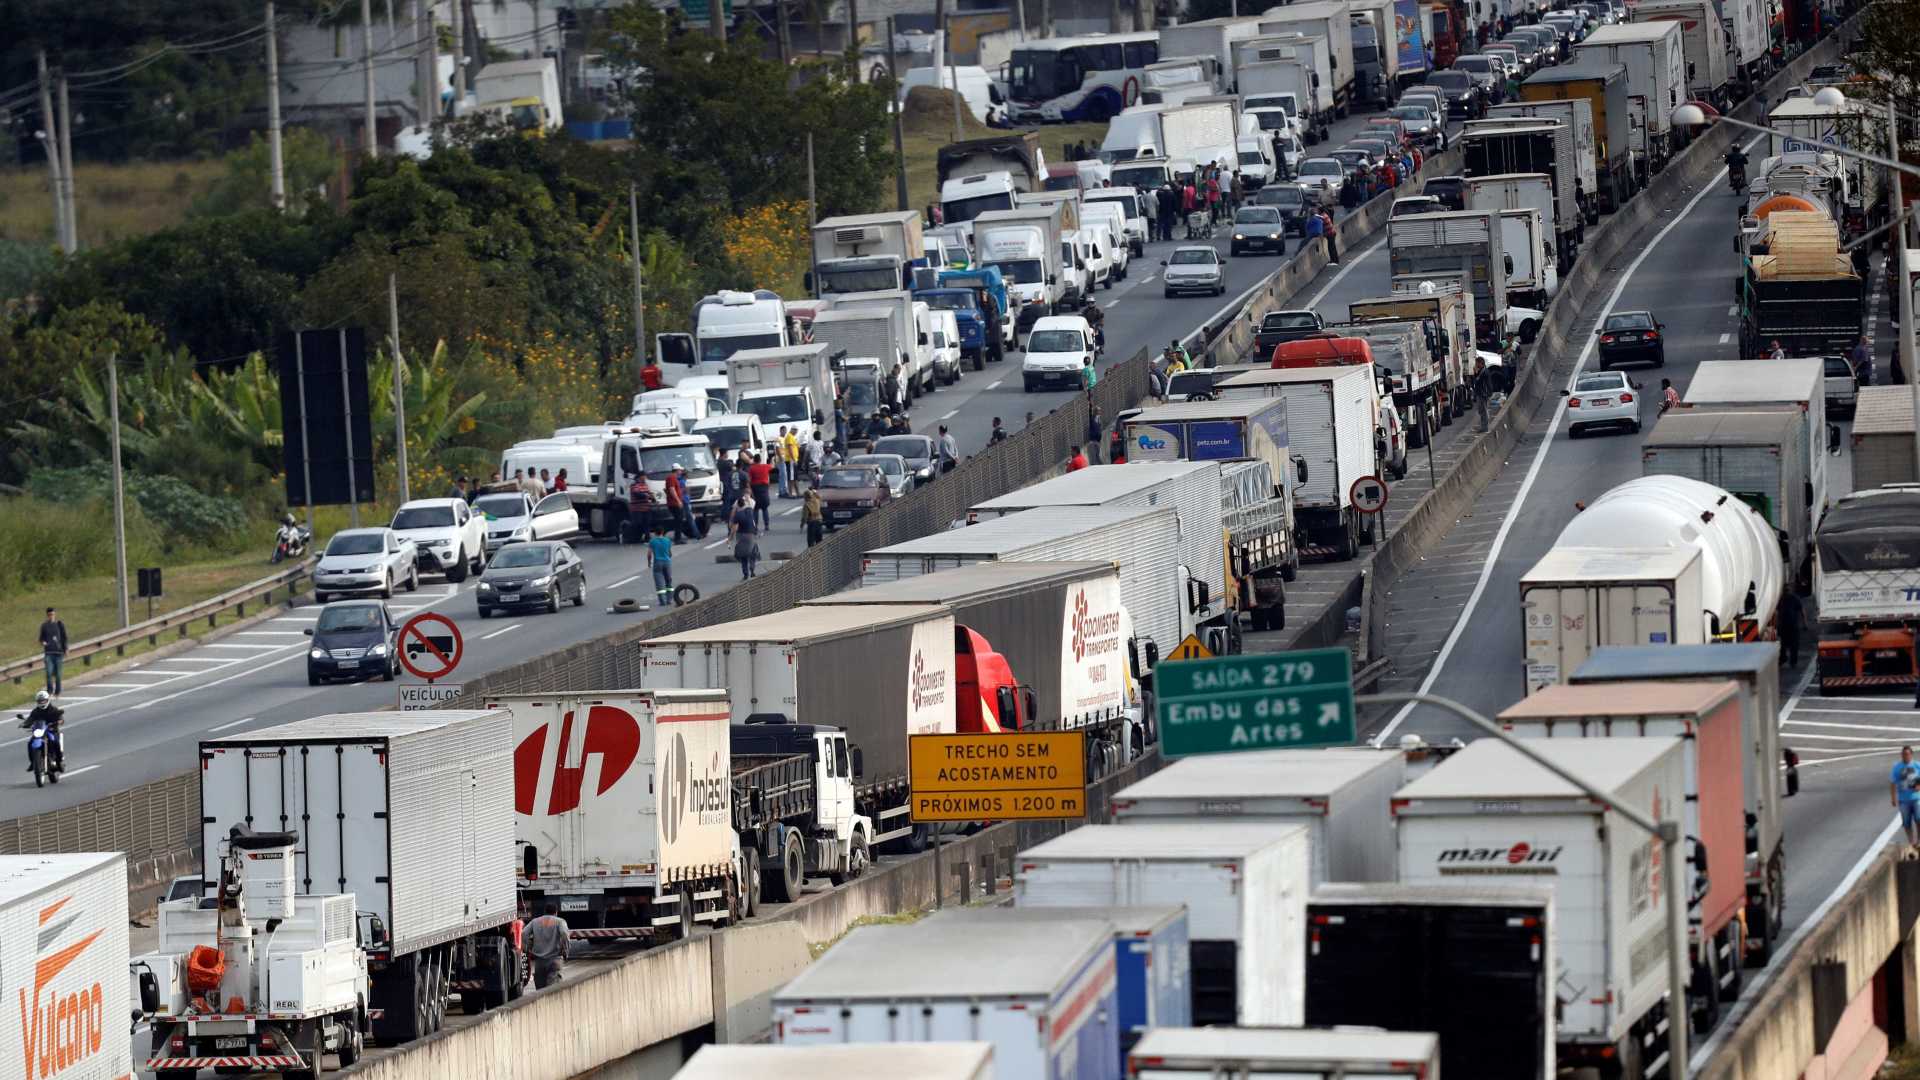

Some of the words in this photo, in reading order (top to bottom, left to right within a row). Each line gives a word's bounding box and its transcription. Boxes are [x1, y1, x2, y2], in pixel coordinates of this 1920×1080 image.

[1197, 438, 1230, 448] petz.com.br
[1086, 637, 1119, 657] TRANSPORTES
[1192, 665, 1254, 690] SAÍDA
[1263, 661, 1315, 686] 279
[401, 688, 461, 701] VEÍCULOS
[1169, 701, 1242, 724] Embu
[1254, 697, 1301, 717] das
[1230, 722, 1304, 745] Artes
[944, 744, 1009, 759] TRECHO
[1016, 743, 1049, 758] SEM
[938, 766, 1058, 782] ACOSTAMENTO
[920, 793, 1003, 814] PRÓXIMOS
[1013, 796, 1056, 811] 1.200
[1061, 801, 1077, 811] m
[276, 1001, 298, 1009] REAL
[20, 980, 103, 1080] Vulcano
